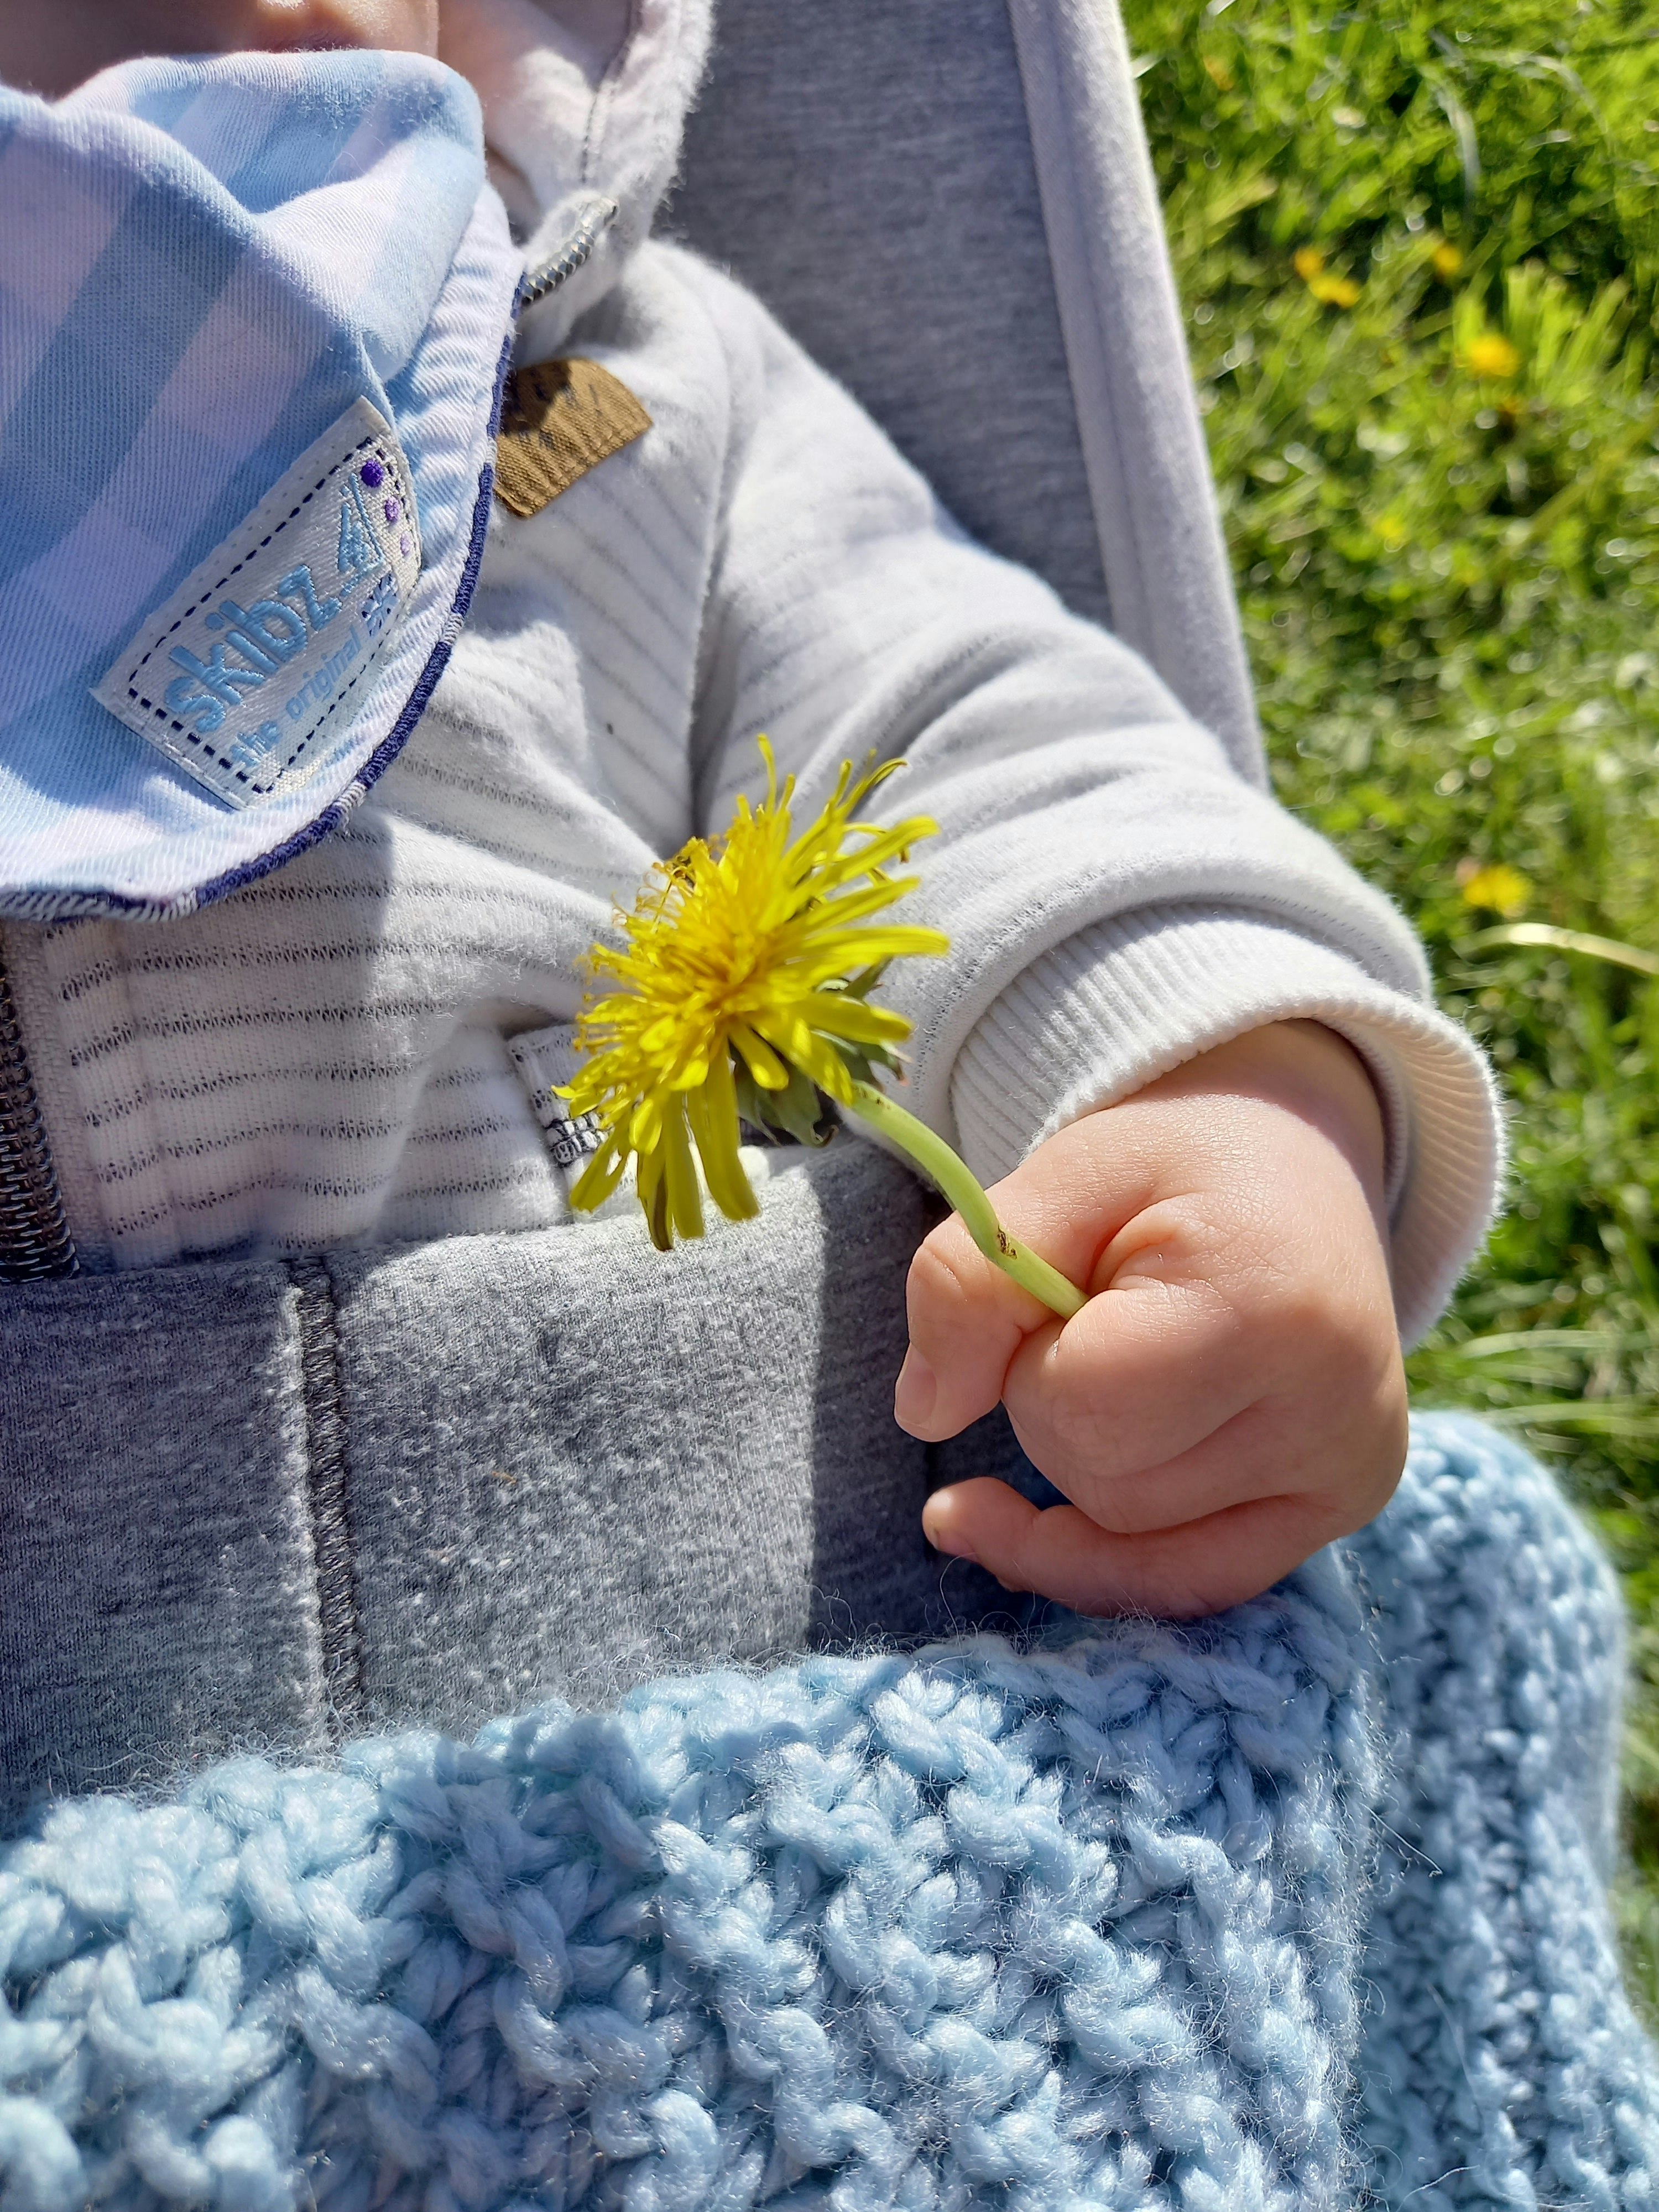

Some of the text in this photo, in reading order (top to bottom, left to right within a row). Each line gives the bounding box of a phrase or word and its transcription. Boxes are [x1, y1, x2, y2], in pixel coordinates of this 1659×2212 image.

[166, 565, 341, 733] skibz
[230, 625, 362, 766] the original
